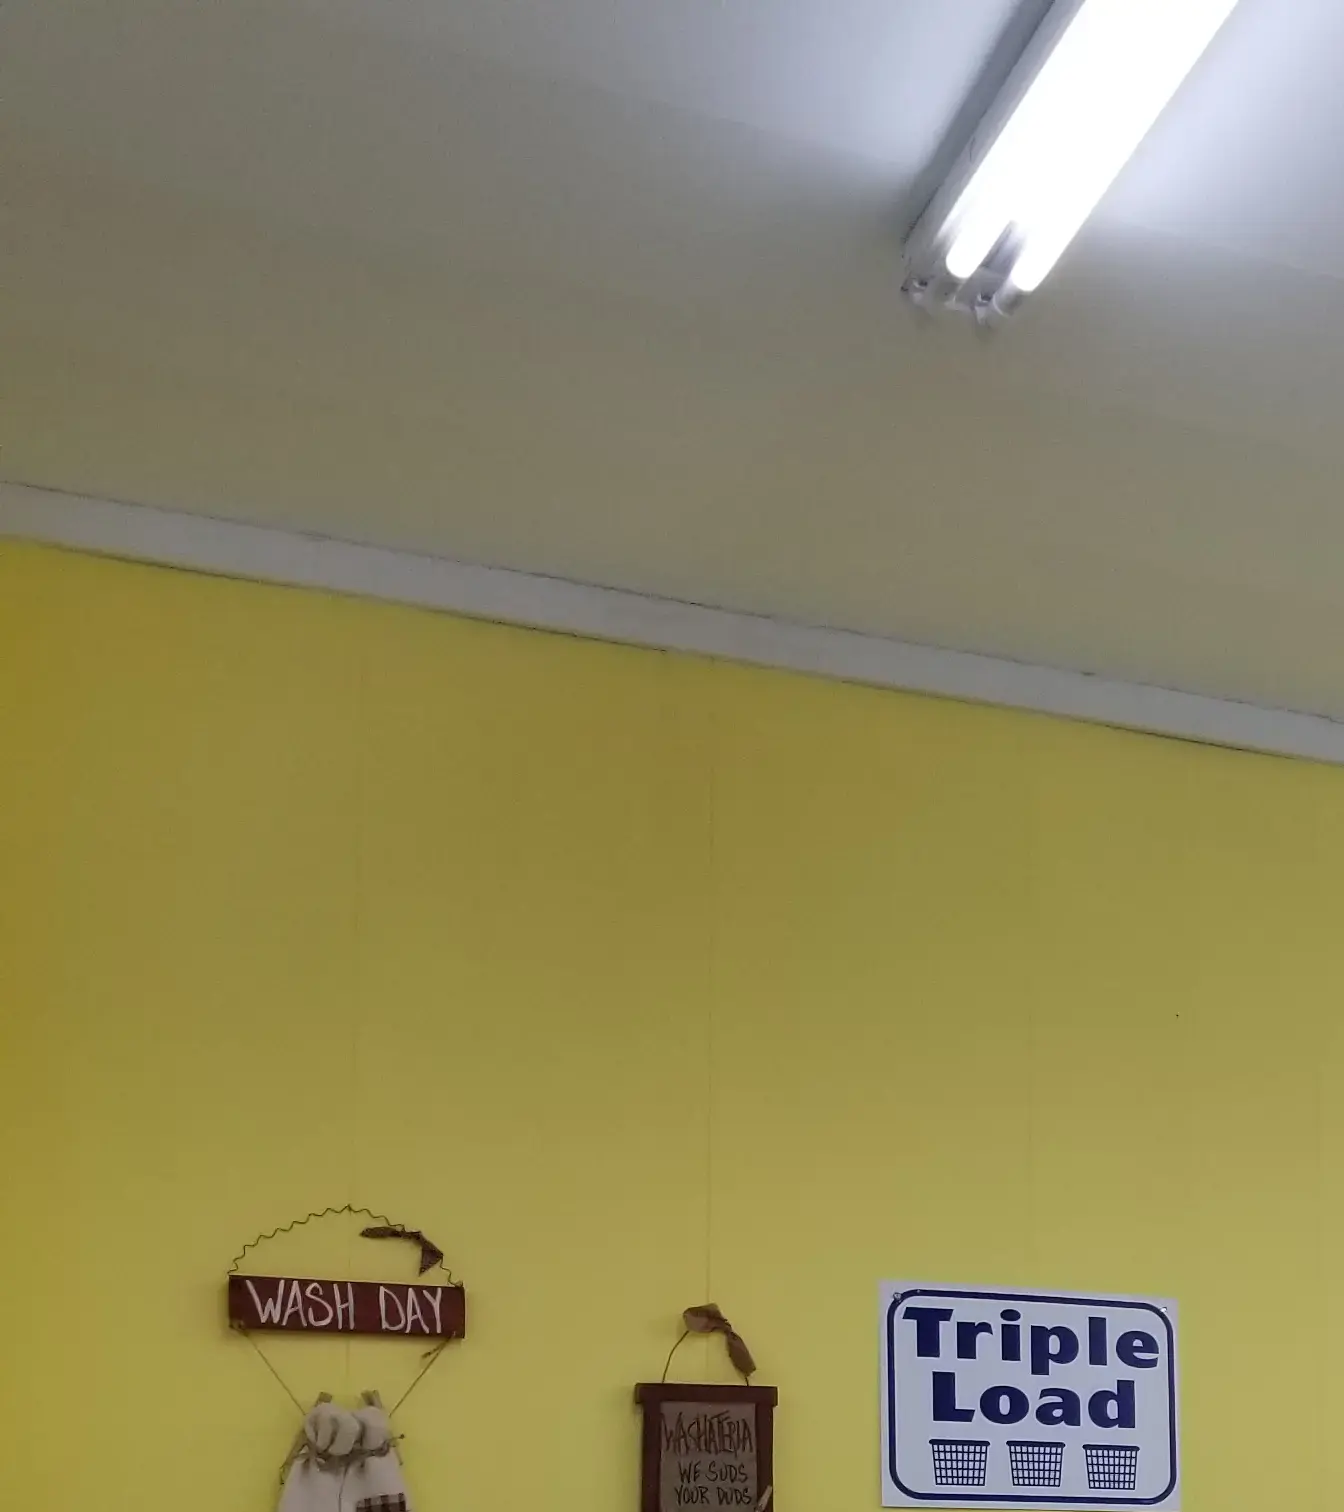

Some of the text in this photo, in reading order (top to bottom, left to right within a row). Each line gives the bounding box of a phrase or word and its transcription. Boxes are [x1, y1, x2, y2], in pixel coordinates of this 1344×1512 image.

[245, 1279, 443, 1334] WASH DAY
[902, 1306, 1160, 1375] Triple
[931, 1371, 1137, 1429] Load
[661, 1410, 754, 1458] WASHATERIA
[674, 1485, 752, 1506] YOUR DUDS
[678, 1460, 748, 1483] WE SUDS
